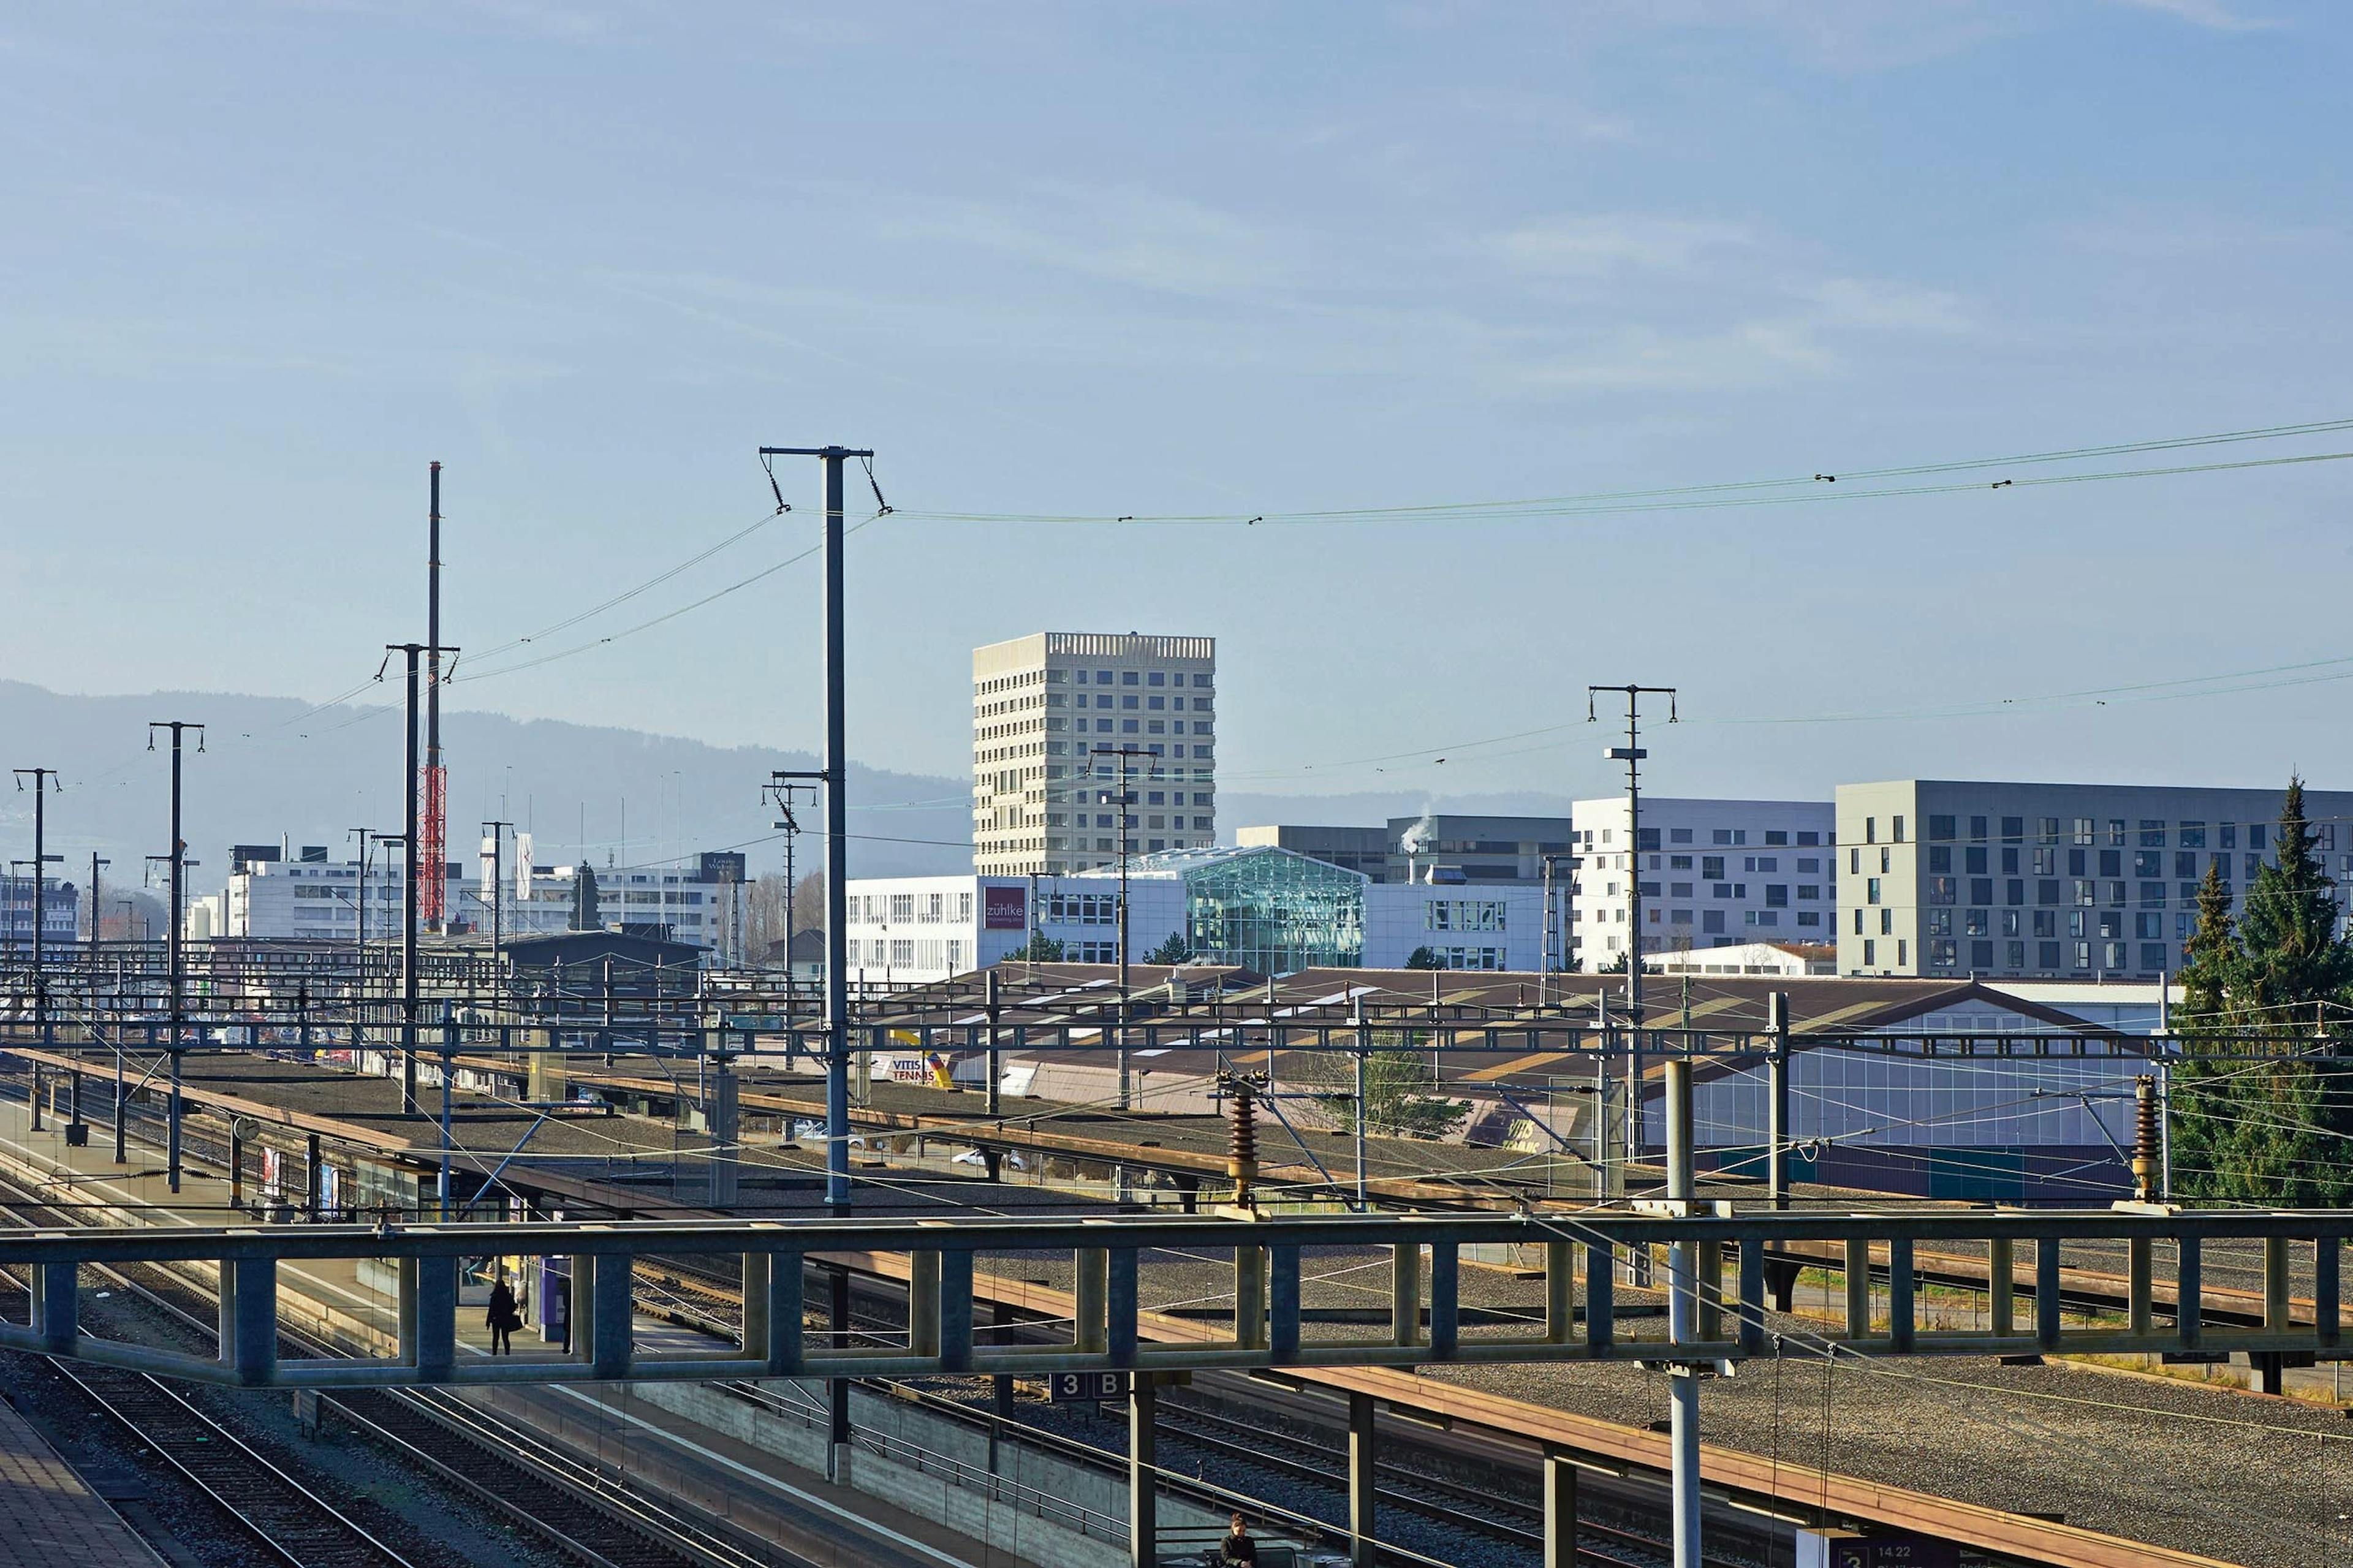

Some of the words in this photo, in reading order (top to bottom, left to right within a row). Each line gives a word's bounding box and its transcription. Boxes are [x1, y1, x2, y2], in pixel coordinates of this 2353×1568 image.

[987, 903, 1023, 917] zühlke
[893, 1060, 921, 1070] VITIS
[893, 1070, 934, 1081] TENNIS
[1064, 1374, 1078, 1394] 3
[1102, 1374, 1117, 1393] B
